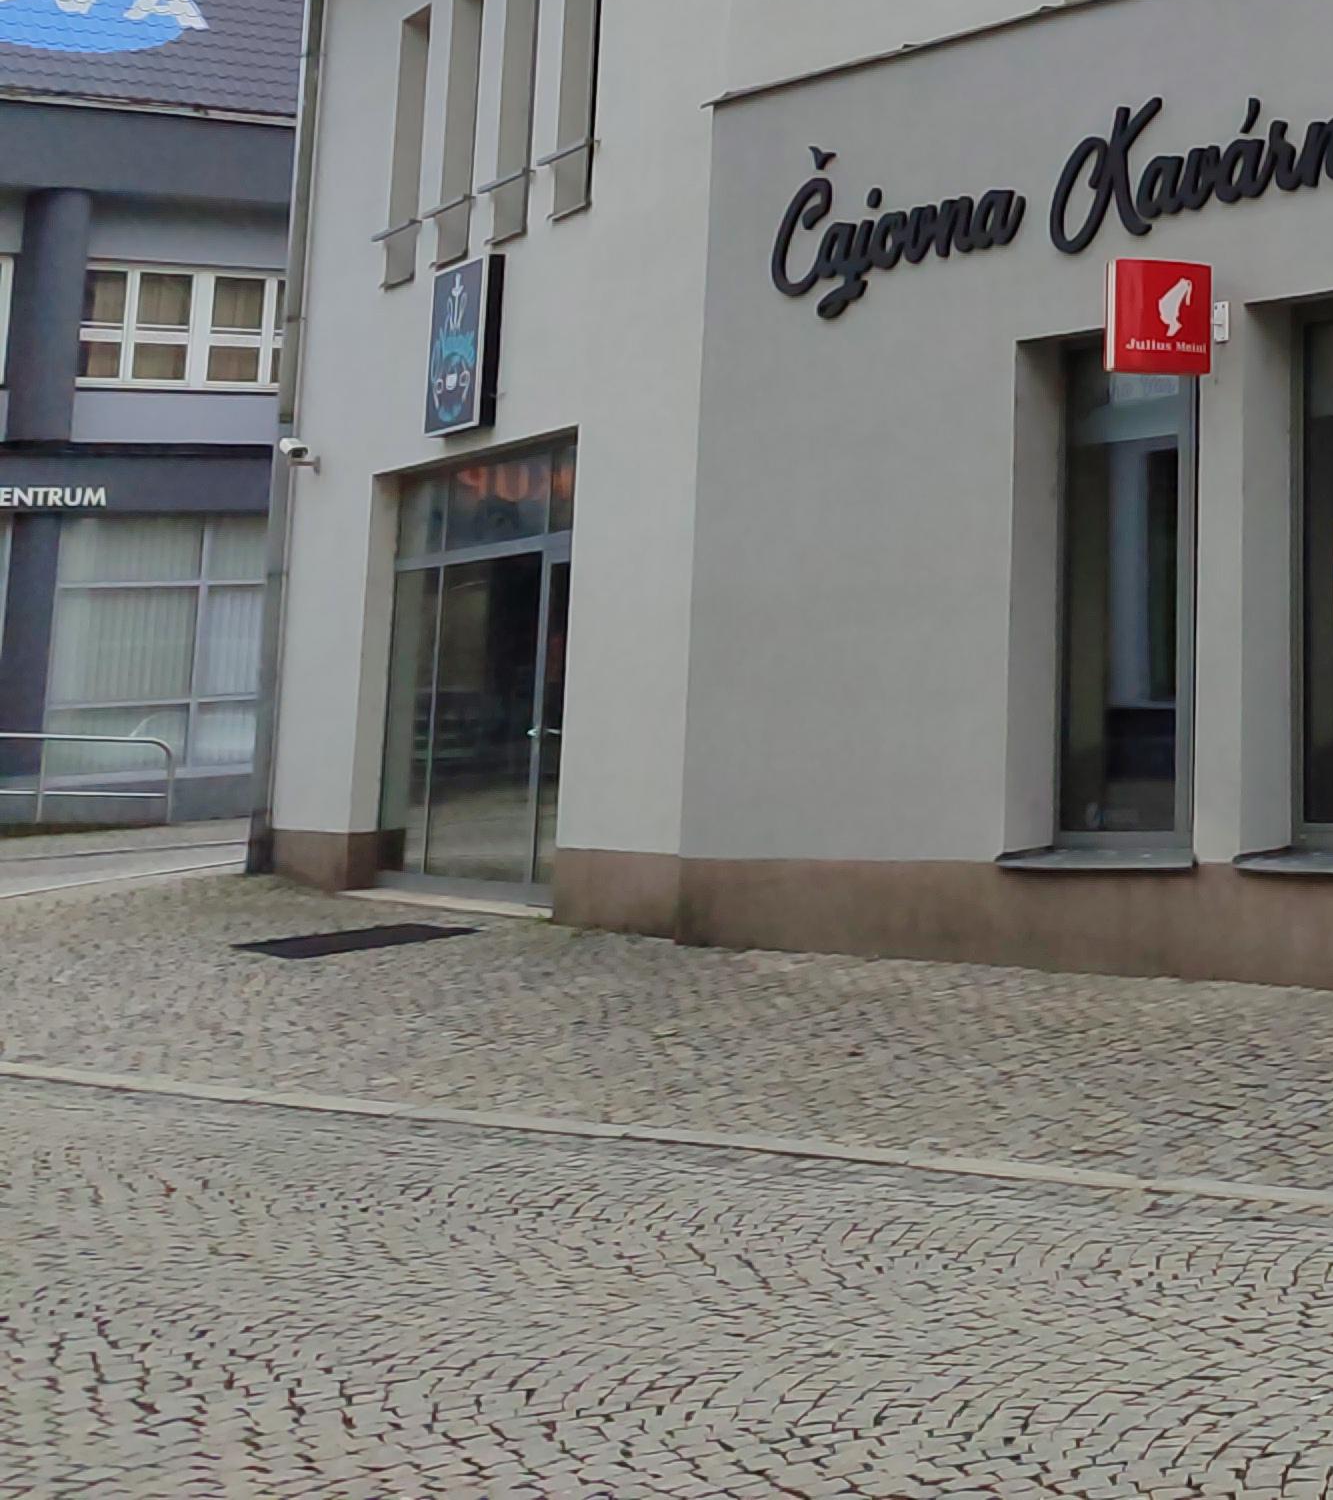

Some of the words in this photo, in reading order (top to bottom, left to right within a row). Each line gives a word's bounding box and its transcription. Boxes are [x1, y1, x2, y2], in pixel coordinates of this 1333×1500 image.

[771, 146, 1027, 320] Čajovna
[1125, 337, 1172, 351] Julius
[0, 486, 107, 508] ENTRUM
